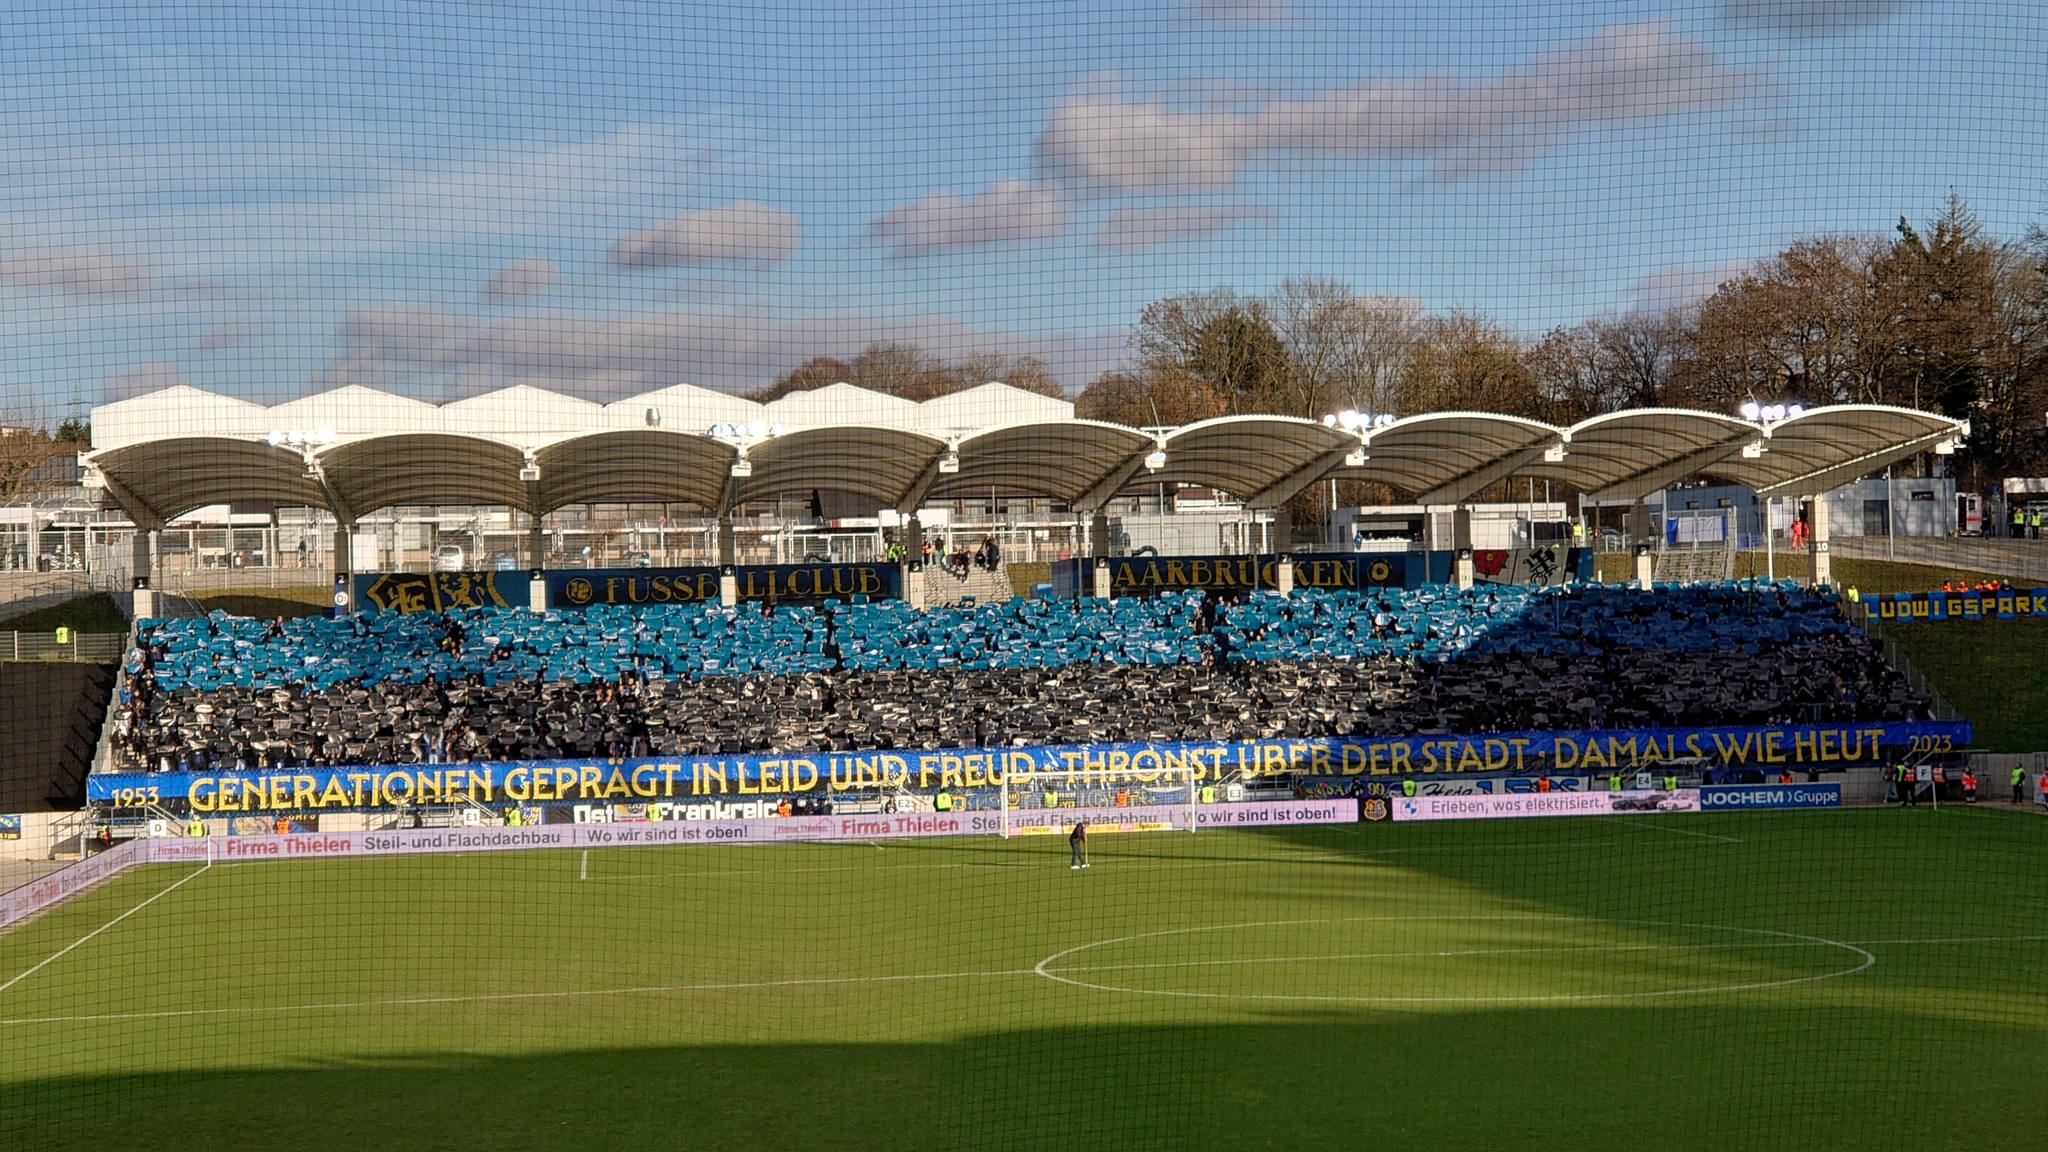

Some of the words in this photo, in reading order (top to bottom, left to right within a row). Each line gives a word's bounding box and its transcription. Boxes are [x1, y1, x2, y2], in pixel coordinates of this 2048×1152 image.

[1640, 547, 1647, 555] 9
[1816, 542, 1828, 551] 10
[1099, 558, 1105, 567] 6
[1282, 554, 1288, 563] 7
[724, 566, 731, 575] 4
[913, 563, 919, 572] 5
[534, 570, 541, 579] 3
[1109, 559, 1356, 587] AARBRÜCKEN
[338, 575, 345, 583] 2
[606, 566, 882, 603] FUSSBLLCLUB
[1863, 595, 2047, 619] LUDWIGSPARK
[111, 786, 159, 807] 1953
[188, 769, 493, 812] GENERATIONEN
[504, 757, 682, 800] GEPRÄGT
[692, 761, 729, 796] IN
[738, 759, 819, 794] LEID
[830, 755, 907, 791] UND
[919, 751, 1036, 789] FREUD
[1060, 747, 1228, 784] THRONST
[1237, 738, 1333, 778] ÜBER
[1342, 743, 1416, 777] DER
[1422, 737, 1530, 774] STADT
[1555, 732, 1703, 769] DAMALS
[1712, 731, 1786, 764] WIE
[1795, 728, 1886, 762] HEUT
[1910, 734, 1953, 754] 2023
[1638, 777, 1650, 785] E4
[1229, 789, 1241, 798] E3
[1702, 790, 1784, 806] JOCHEM
[1794, 790, 1838, 805] Gruppe
[898, 799, 911, 808] E2
[1431, 800, 1488, 813] Erleben,
[1493, 801, 1520, 811] was
[1526, 798, 1604, 811] elektrisiert.
[466, 813, 477, 822] E1
[1211, 809, 1232, 822] wir
[1238, 808, 1268, 822] sind
[1274, 808, 1291, 821] ist
[1295, 806, 1336, 820] oben!
[841, 819, 891, 835] Firma
[896, 816, 959, 832] Thielen
[1016, 815, 1044, 827] und
[1050, 811, 1157, 827] Flachdachbau
[154, 824, 162, 832] D
[587, 829, 612, 843] Wo
[617, 828, 638, 841] wir
[645, 827, 677, 841] sind
[683, 826, 701, 839] ist
[706, 825, 748, 839] oben!
[226, 840, 278, 856] Firma
[283, 836, 351, 854] Thielen
[365, 836, 406, 850] Steil-
[412, 835, 441, 849] und
[449, 831, 560, 847] Flachdachbau
